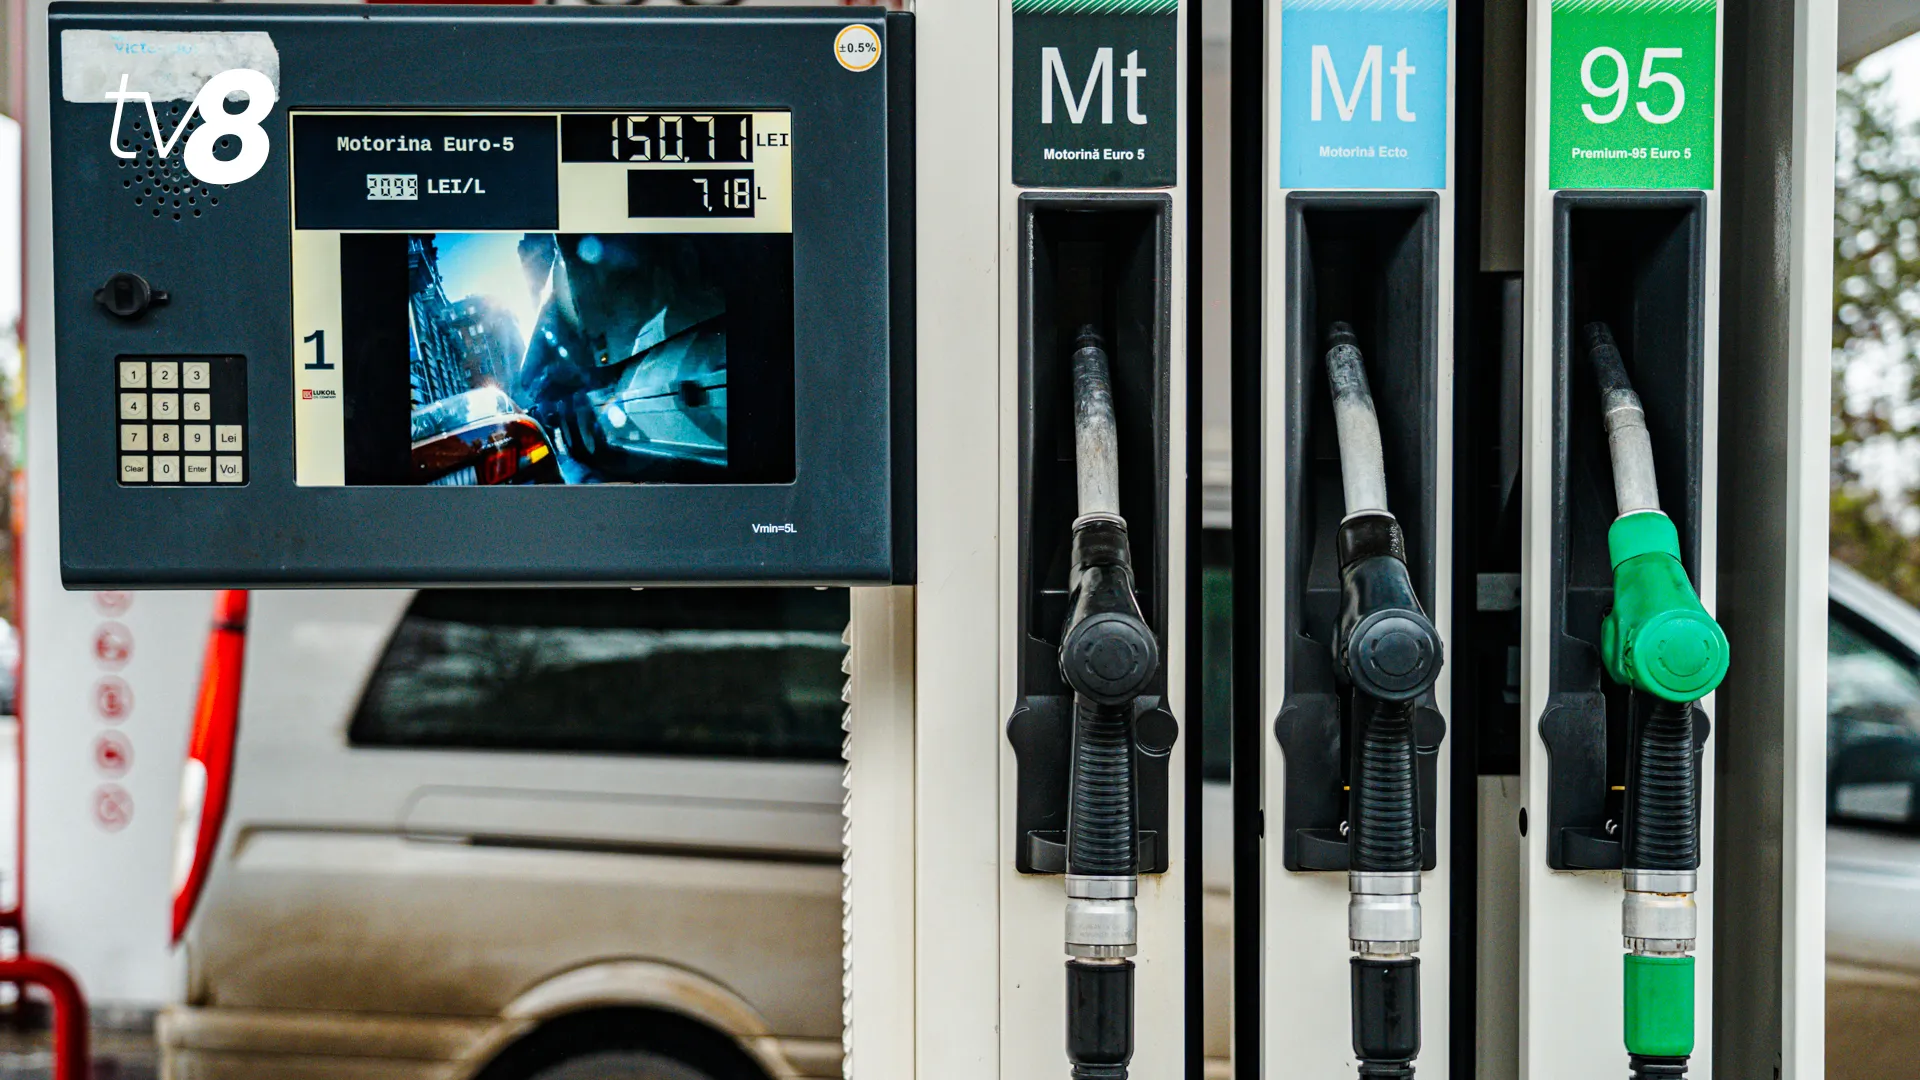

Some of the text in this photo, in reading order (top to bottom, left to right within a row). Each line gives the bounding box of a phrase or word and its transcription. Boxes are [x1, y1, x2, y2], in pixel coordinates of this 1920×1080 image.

[839, 43, 877, 53] ±0.5%
[1041, 47, 1148, 125] Mt
[1311, 45, 1417, 122] Mt
[1580, 46, 1686, 124] 95
[336, 135, 515, 152] Motorina Euro-5
[757, 133, 789, 147] LEI
[1044, 148, 1145, 160] Motorină Euro 5
[1379, 146, 1408, 158] Ecto
[1572, 147, 1691, 159] Premium-95 Euro 5
[427, 178, 486, 194] LEI/L
[757, 186, 767, 200] L
[303, 329, 335, 370] 1
[130, 370, 137, 380] 1
[161, 370, 169, 380] 2
[193, 371, 201, 380] 3
[130, 402, 138, 411] 4
[162, 402, 169, 411] 5
[193, 402, 201, 411] 6
[131, 433, 138, 442] 7
[162, 433, 170, 442] 8
[193, 433, 201, 442] 9
[221, 434, 237, 442] Lei
[163, 464, 170, 473] 0
[220, 465, 240, 474] Vol.
[751, 523, 798, 533] Vmin=5L
